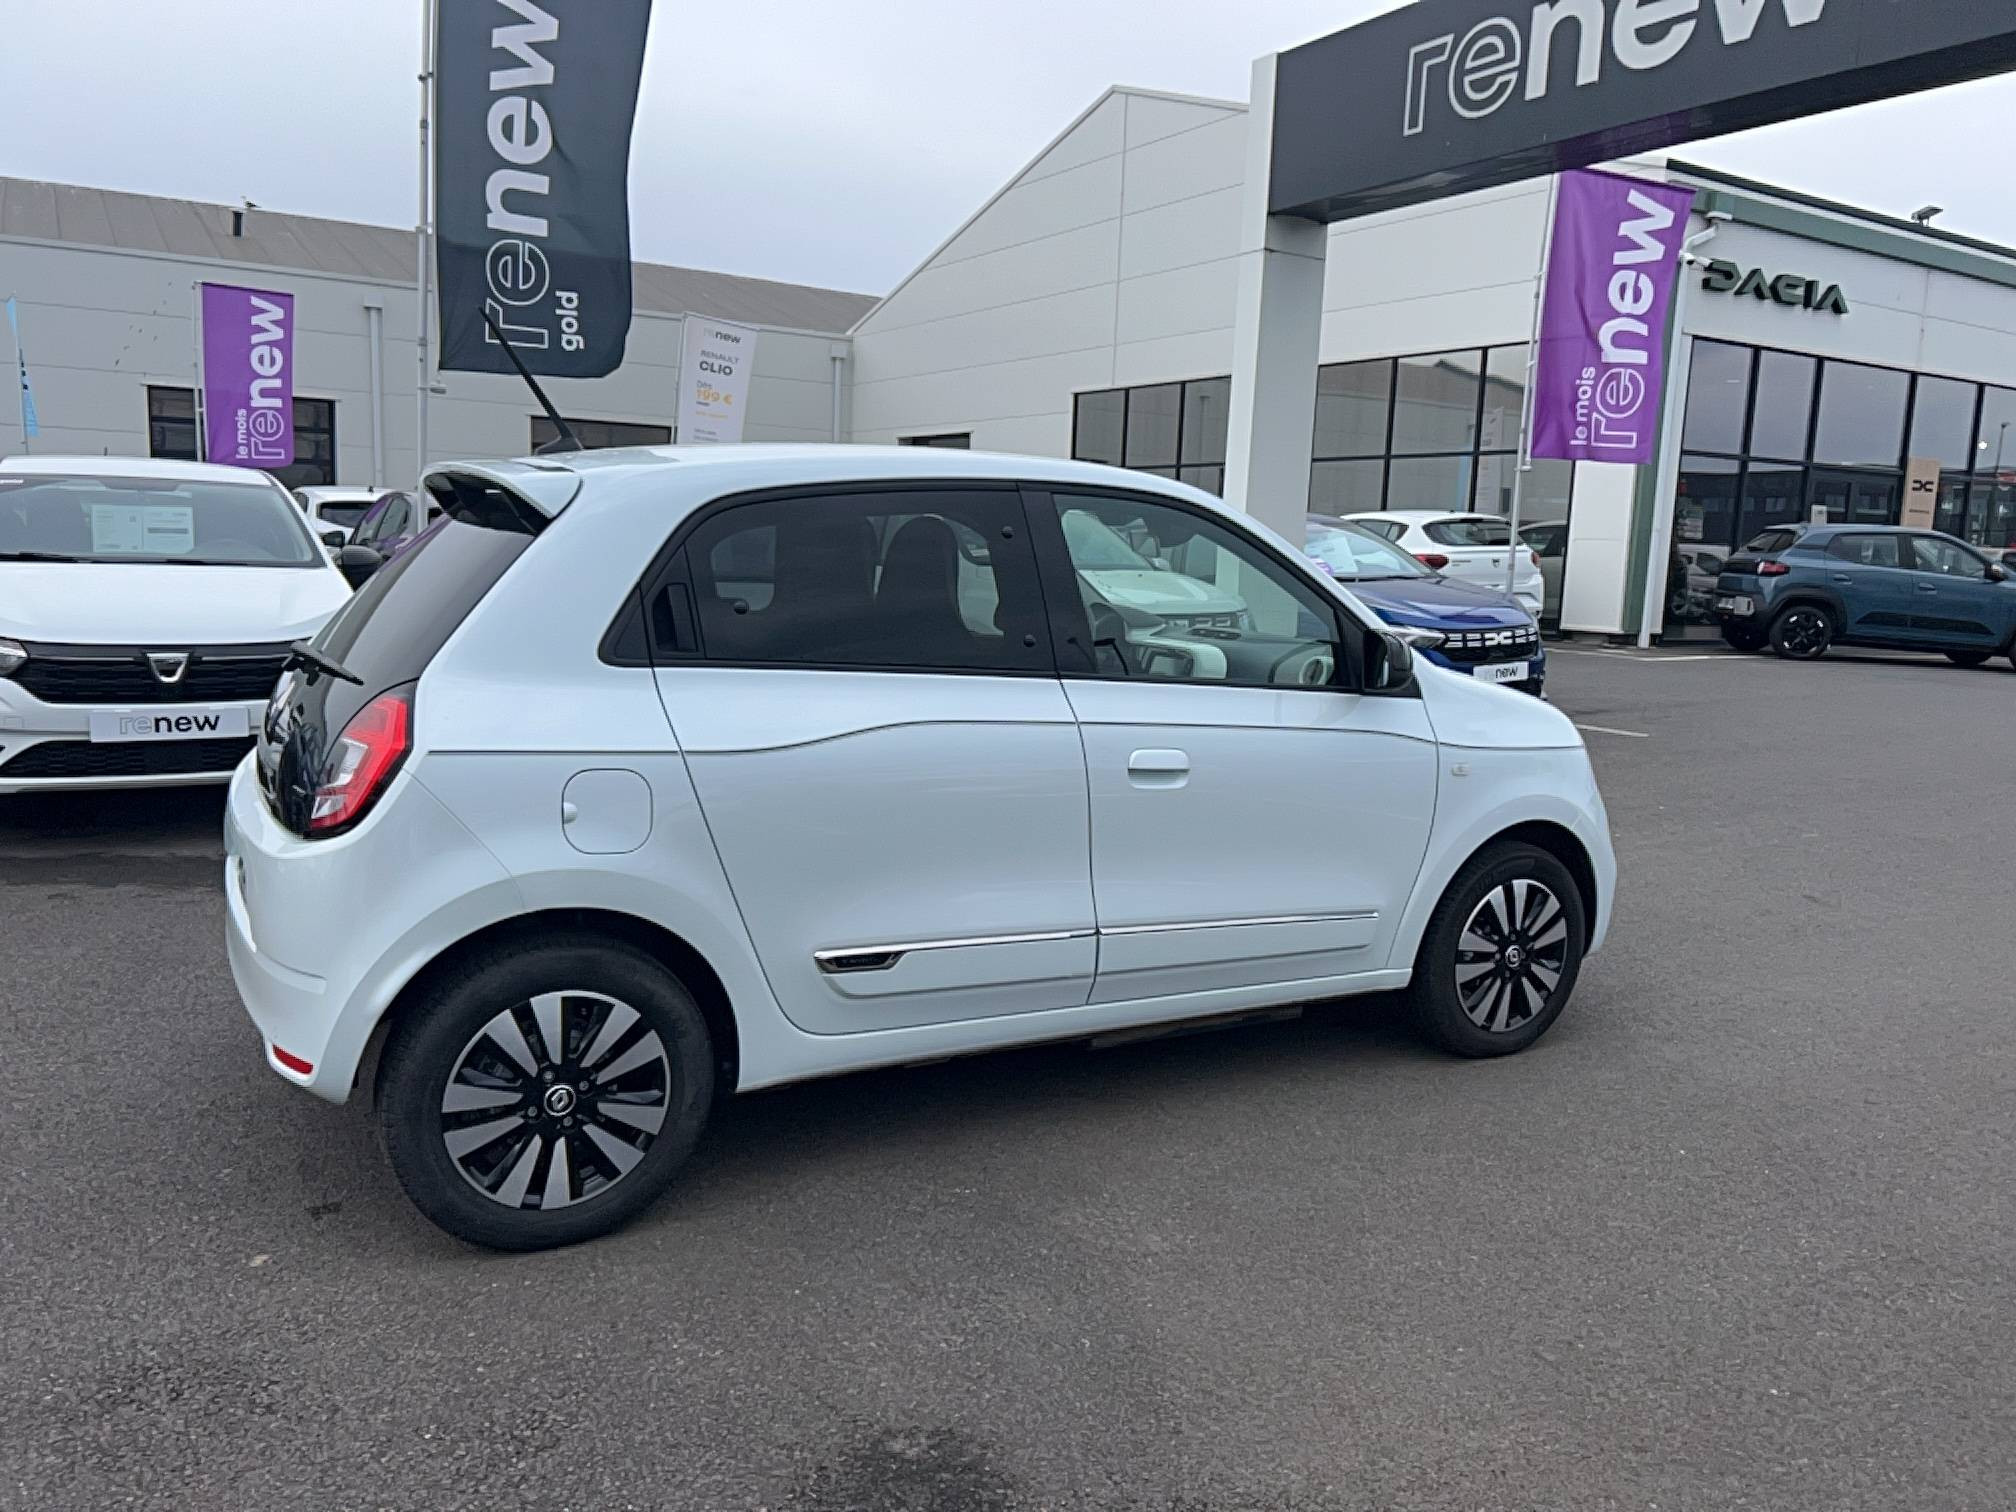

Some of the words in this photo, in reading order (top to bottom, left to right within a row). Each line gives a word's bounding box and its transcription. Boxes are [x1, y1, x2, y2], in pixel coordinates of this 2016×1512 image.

[485, 0, 560, 349] renew
[1702, 258, 1850, 314] DACIA
[555, 290, 585, 352] gold
[1591, 188, 1676, 449] renew
[249, 295, 285, 460] renew
[699, 360, 733, 376] CLIO
[1576, 366, 1595, 424] mois
[235, 408, 248, 443] mois
[235, 445, 249, 460] le
[1570, 428, 1588, 446] le
[119, 714, 221, 736] renew
